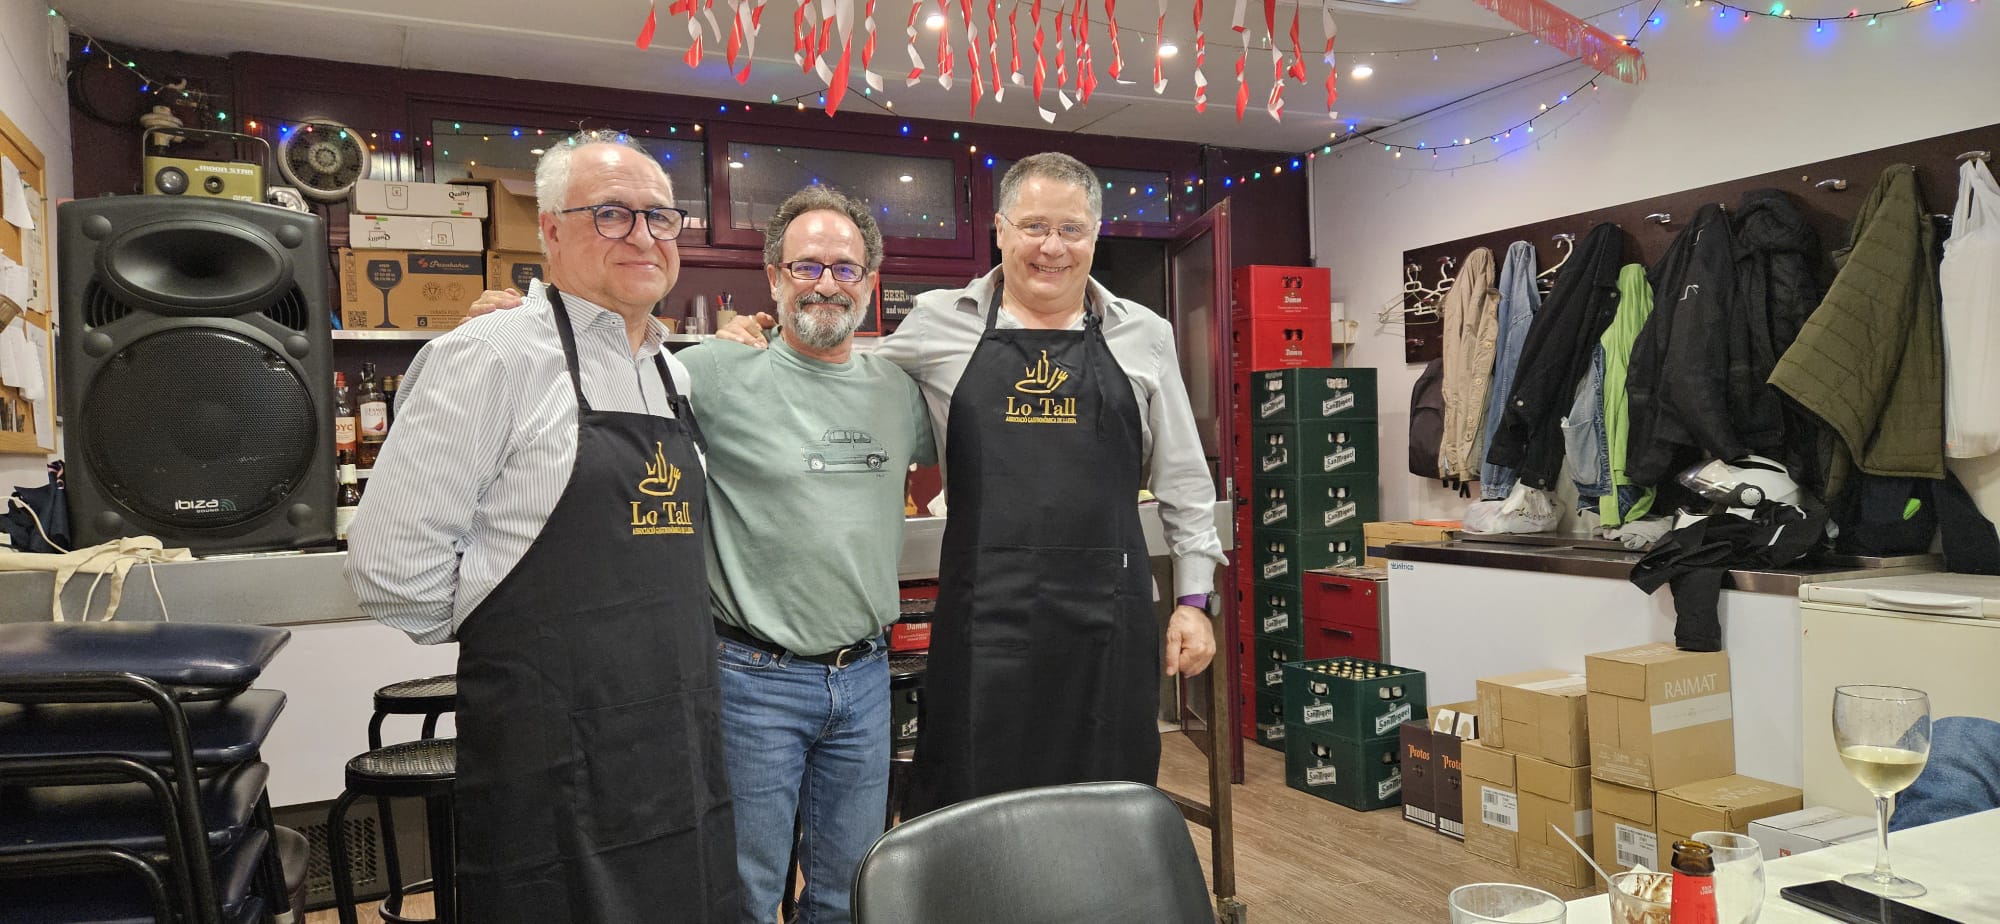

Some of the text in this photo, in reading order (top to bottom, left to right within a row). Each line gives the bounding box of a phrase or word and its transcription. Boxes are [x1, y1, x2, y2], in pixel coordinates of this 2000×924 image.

[884, 289, 905, 302] BEER
[1005, 396, 1077, 416] Lo Tall
[630, 501, 692, 526] Lo Tall
[1663, 672, 1719, 700] RAIMAT
[1408, 743, 1430, 761] Protos
